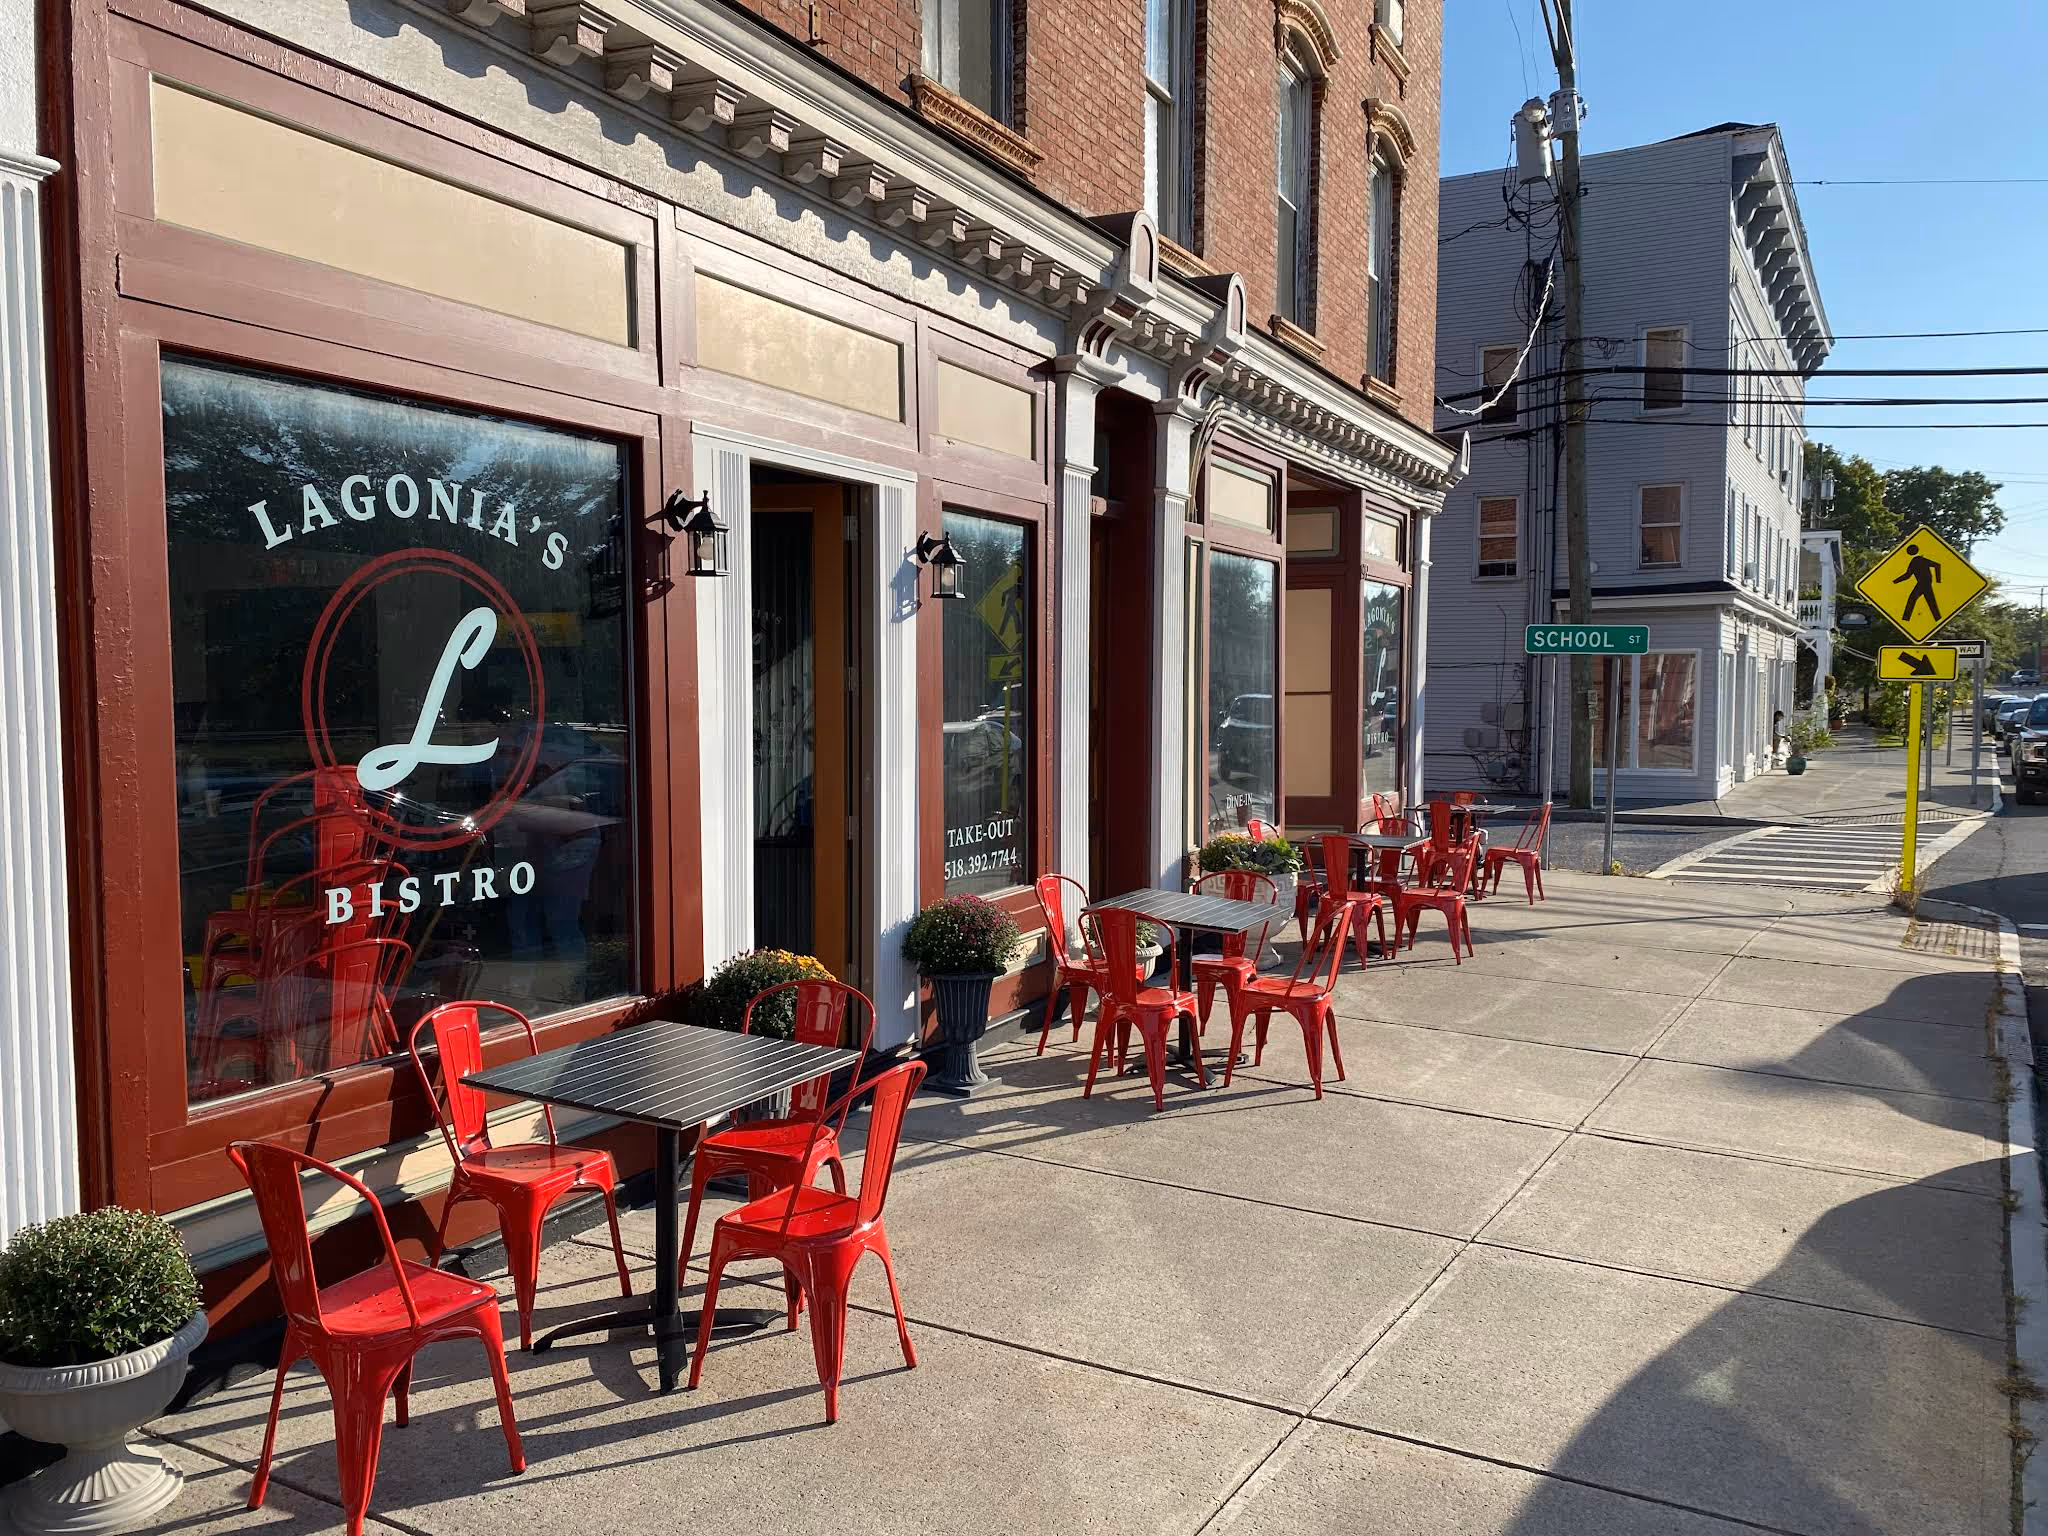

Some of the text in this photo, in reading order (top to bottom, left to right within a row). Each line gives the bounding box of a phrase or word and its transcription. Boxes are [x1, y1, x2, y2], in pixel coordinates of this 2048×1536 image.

[247, 473, 570, 571] LAGONIA'S
[1533, 631, 1641, 648] SCHOOL ST
[1959, 646, 1978, 654] WAY
[1370, 647, 1387, 706] L
[356, 606, 500, 791] L
[1366, 730, 1389, 745] BISTRO
[1226, 792, 1253, 809] DINE-IN
[947, 818, 1014, 848] TAKE-OUT
[944, 847, 1017, 881] 518.392.7744
[325, 861, 536, 925] BISTRO
